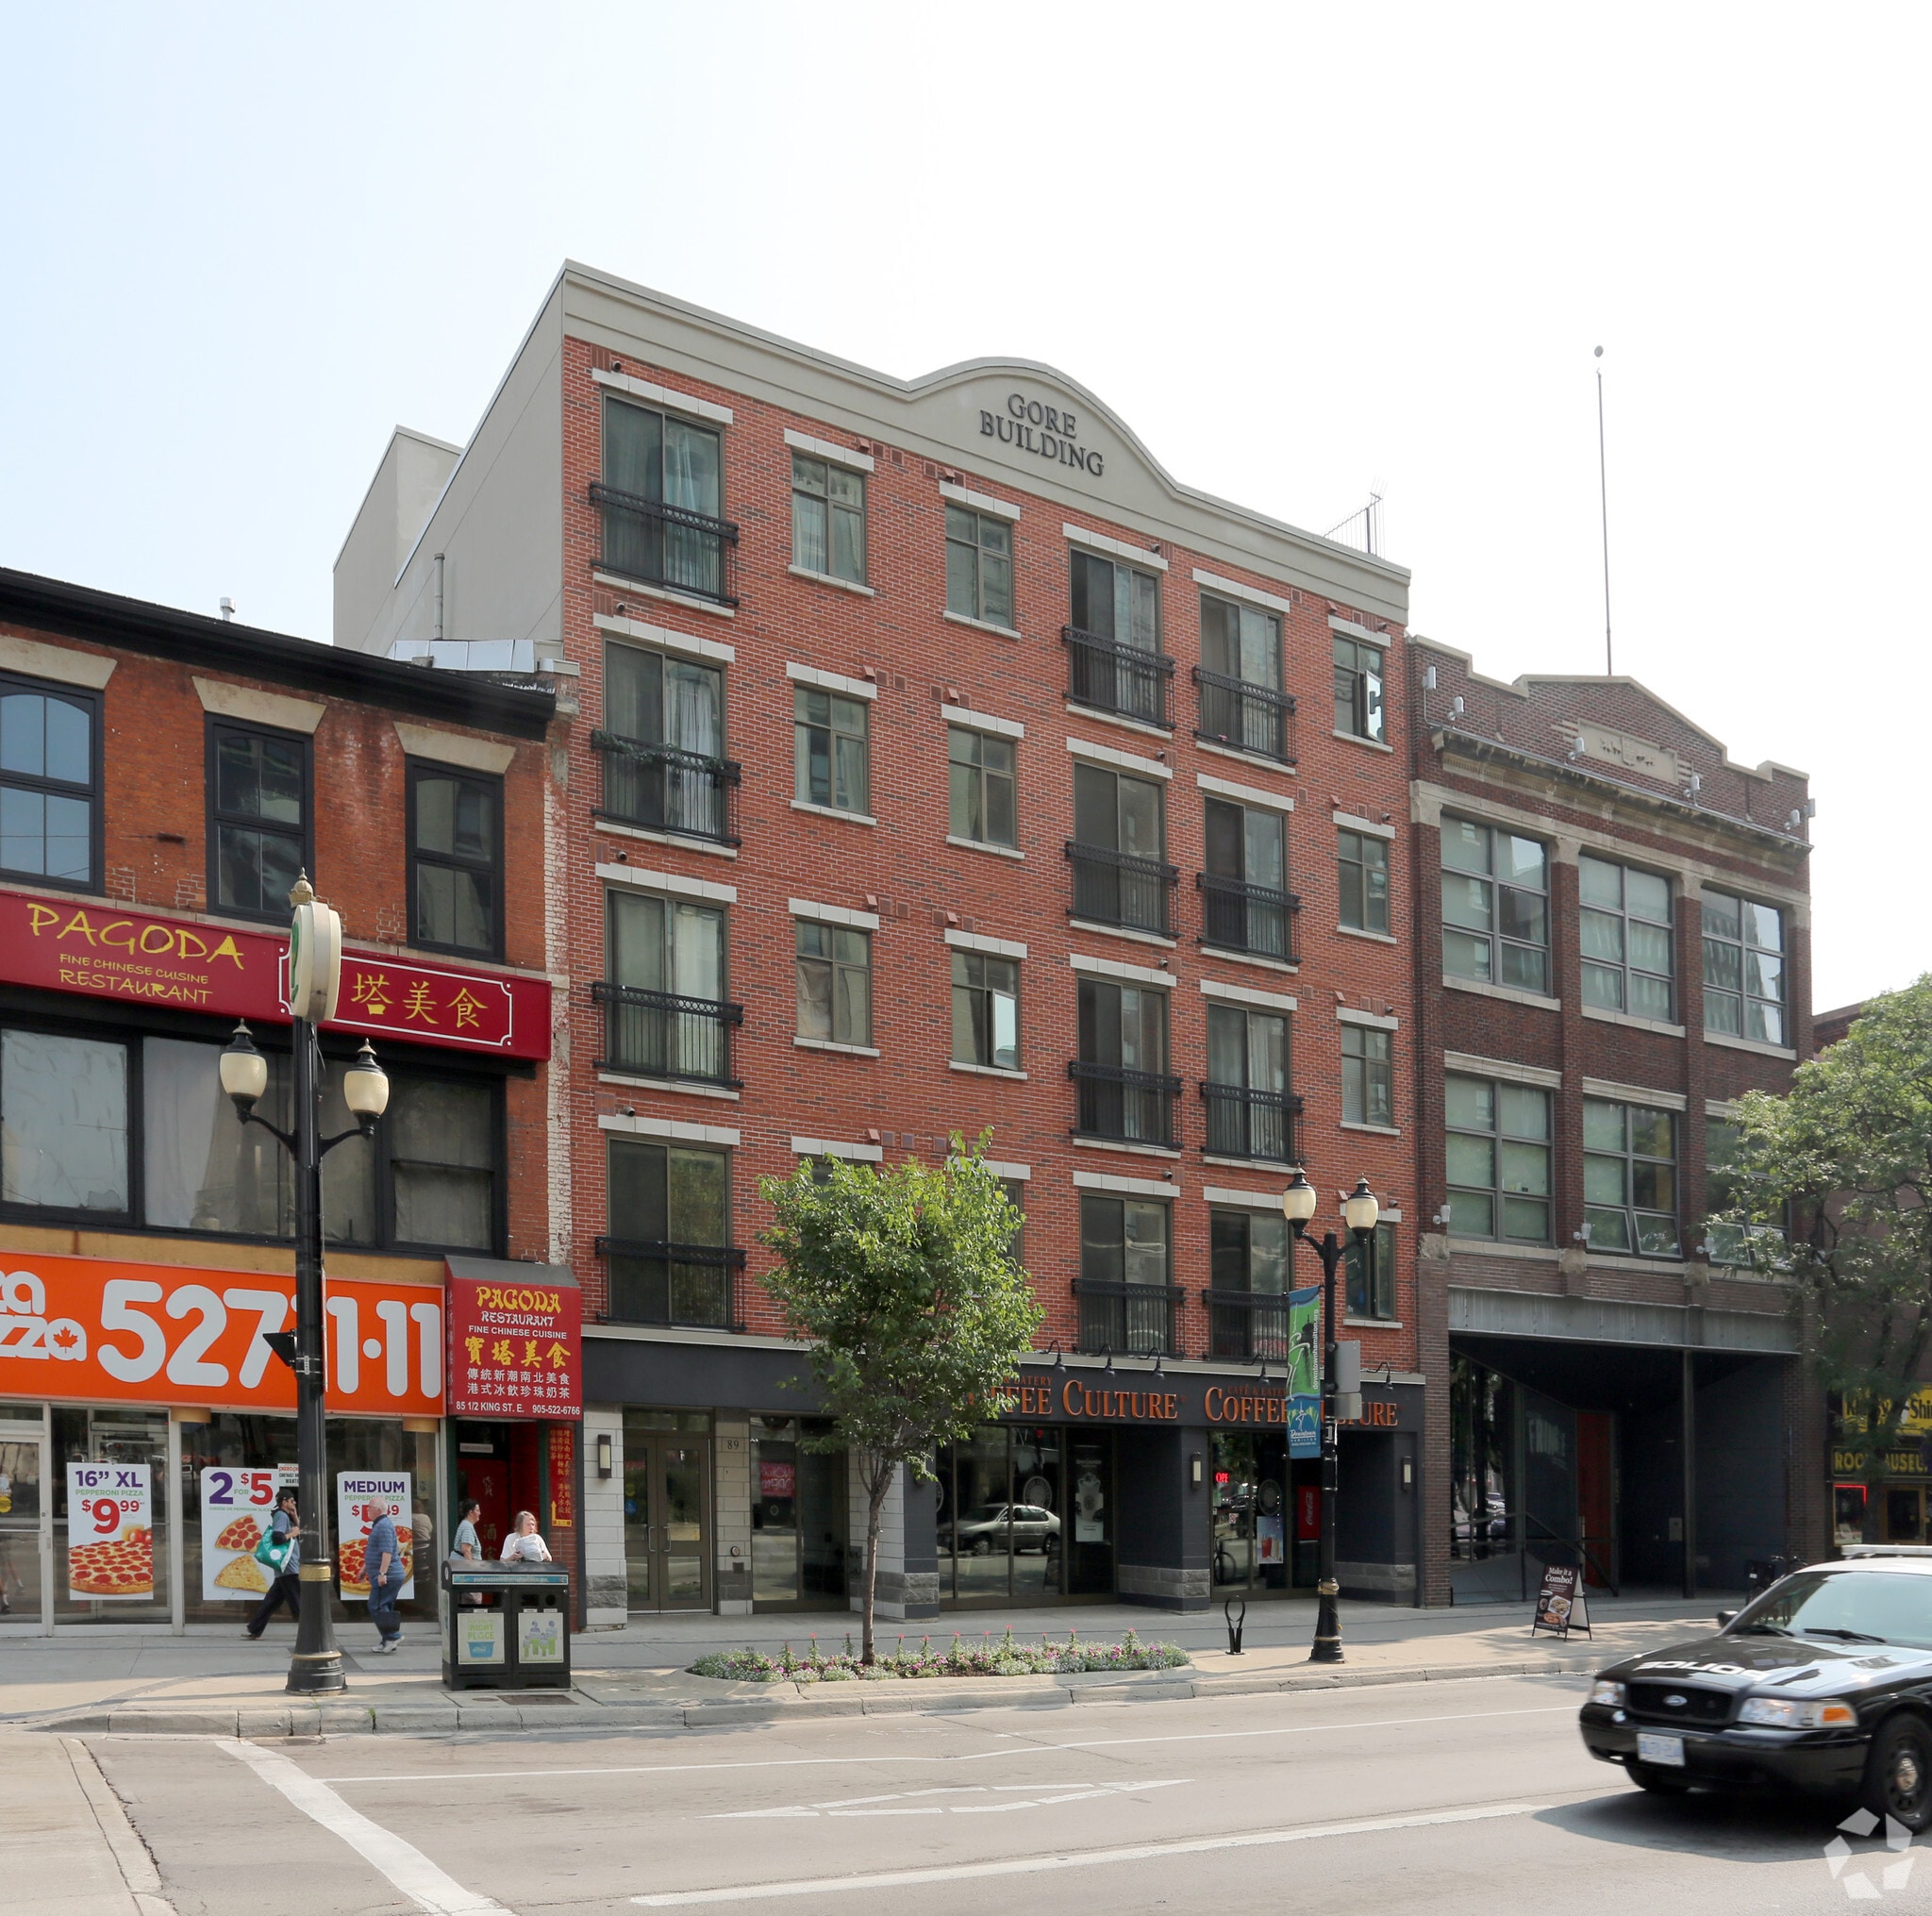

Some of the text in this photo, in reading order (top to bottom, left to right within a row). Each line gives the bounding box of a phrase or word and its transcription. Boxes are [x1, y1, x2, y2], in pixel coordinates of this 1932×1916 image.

[1008, 393, 1077, 440] GORE
[980, 409, 1105, 477] BUILDING
[26, 903, 244, 970] PAGODA
[59, 953, 209, 985] FINE CHINESE CUISINE
[58, 969, 213, 1005] RESTAURANT
[475, 1286, 562, 1313] PAGODA
[480, 1310, 555, 1327] RESTAURANT
[468, 1325, 567, 1340] FINE CHINESE CUISINE
[464, 1336, 572, 1369] 寶塔美食
[466, 1367, 570, 1386] 傳統新潮南北美食
[466, 1382, 571, 1399] 港式冰飲珍珠奶茶
[1062, 1379, 1178, 1420] CULTURE
[456, 1401, 581, 1415] 85 1/2 KING ST. E. 905-522-6766
[726, 1440, 740, 1450] 89
[115, 1471, 143, 1488] XL
[208, 1472, 234, 1505] 2
[343, 1480, 405, 1493] MEDIUM
[1544, 1574, 1574, 1585] Combo!
[1548, 1567, 1563, 1575] Make
